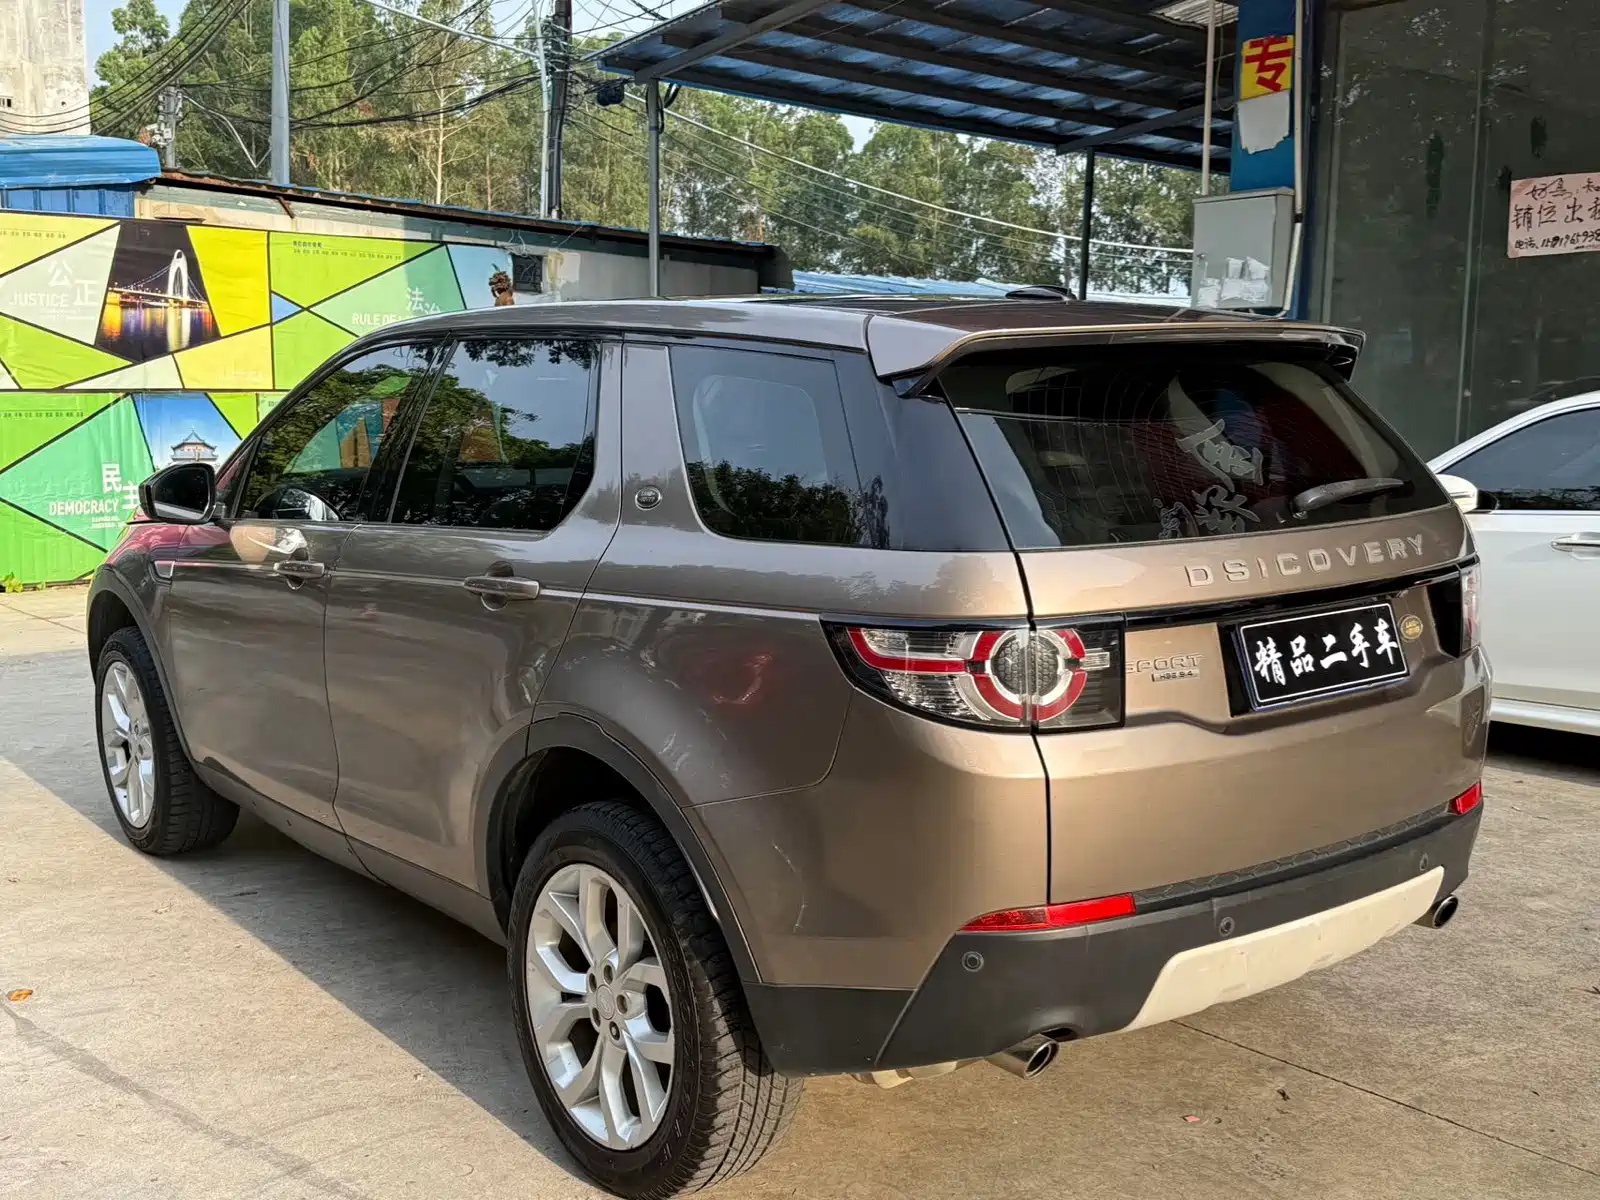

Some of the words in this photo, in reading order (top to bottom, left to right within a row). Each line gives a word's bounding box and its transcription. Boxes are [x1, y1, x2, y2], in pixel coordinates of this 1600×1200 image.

[1244, 35, 1293, 92] 专
[10, 290, 69, 307] JUSTICE
[47, 260, 99, 306] 公正
[352, 313, 381, 326] RULE
[48, 497, 120, 517] DEMOCRACY
[1184, 534, 1424, 588] DSICOVERY
[1254, 617, 1399, 687] 精品二手车
